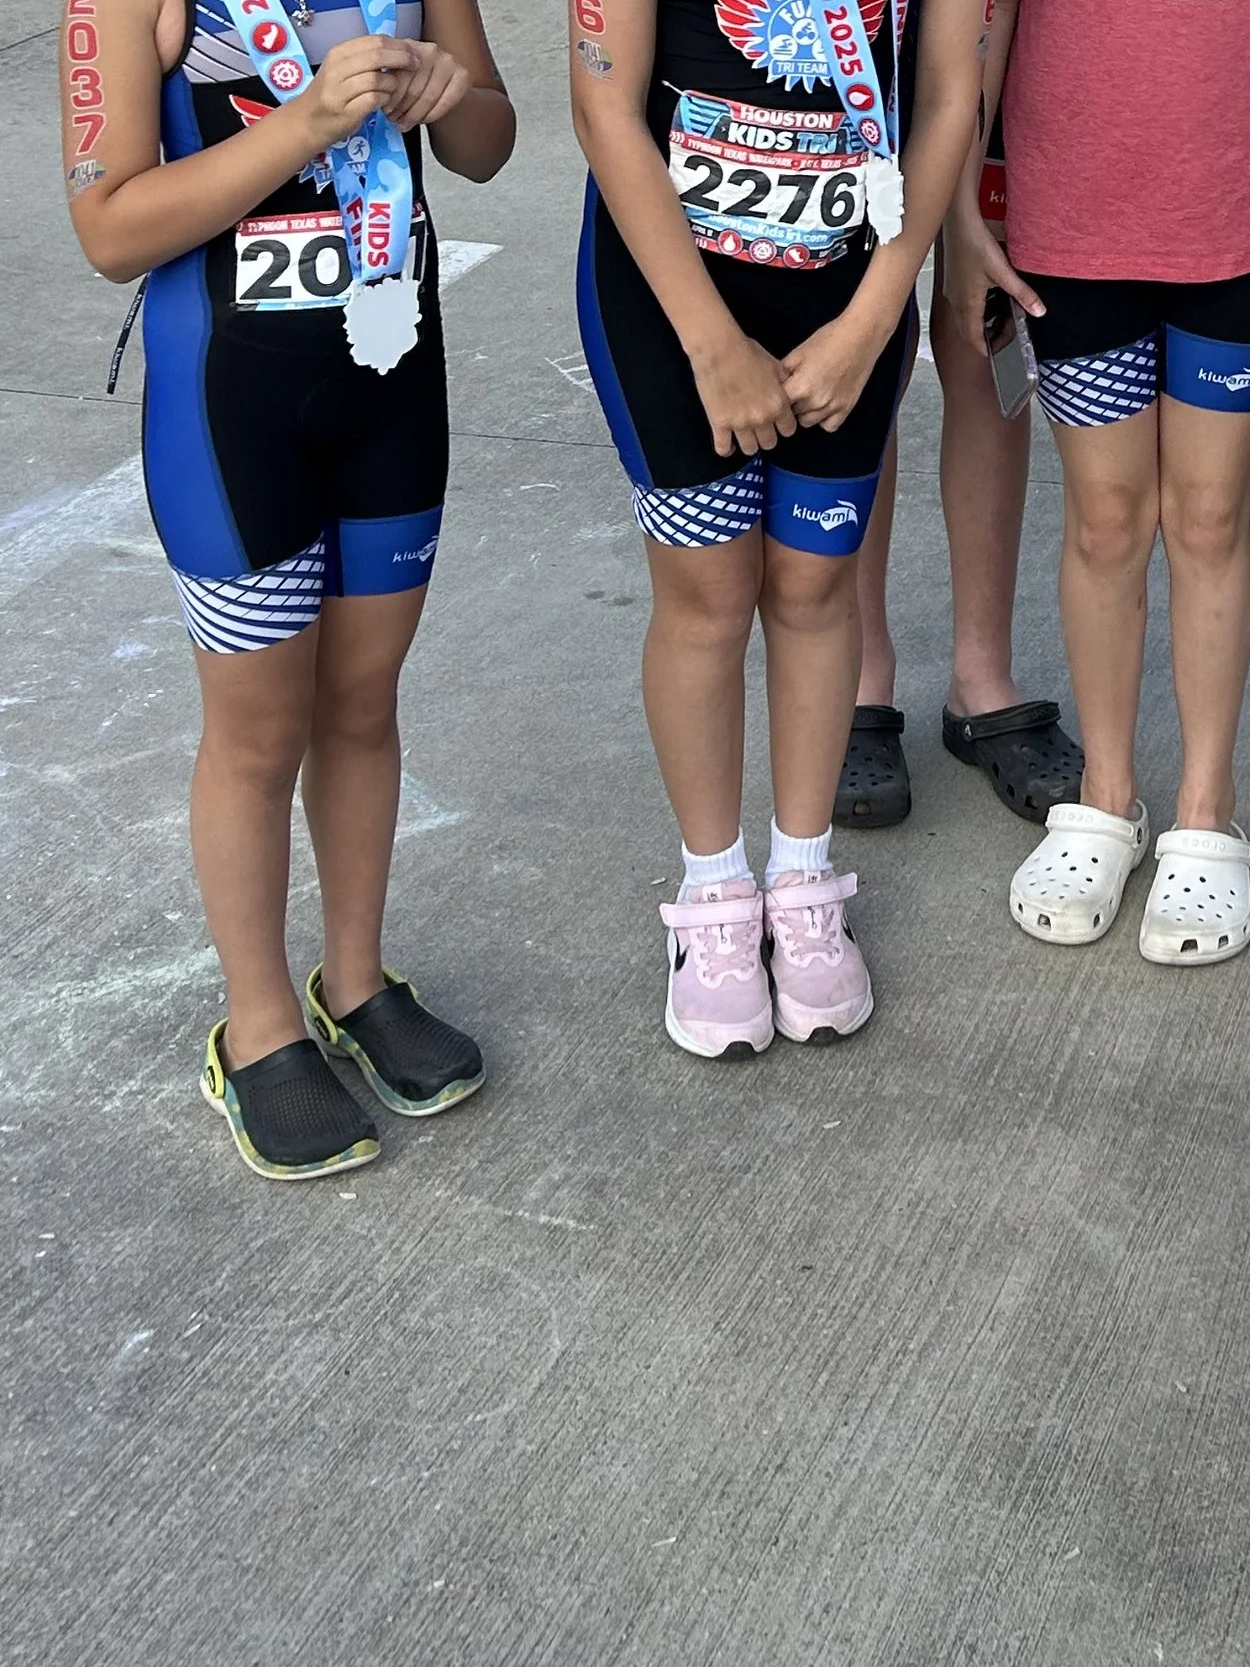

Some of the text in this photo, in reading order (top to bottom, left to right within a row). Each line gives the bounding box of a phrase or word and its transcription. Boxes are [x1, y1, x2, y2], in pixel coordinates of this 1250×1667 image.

[813, 5, 864, 76] 2025
[776, 61, 828, 74] TRI TEAM
[739, 106, 832, 128] HOUSTON
[728, 123, 838, 154] KIDS TRI
[679, 154, 857, 228] 2276
[290, 218, 317, 230] TEXAS
[366, 201, 391, 268] KIDS
